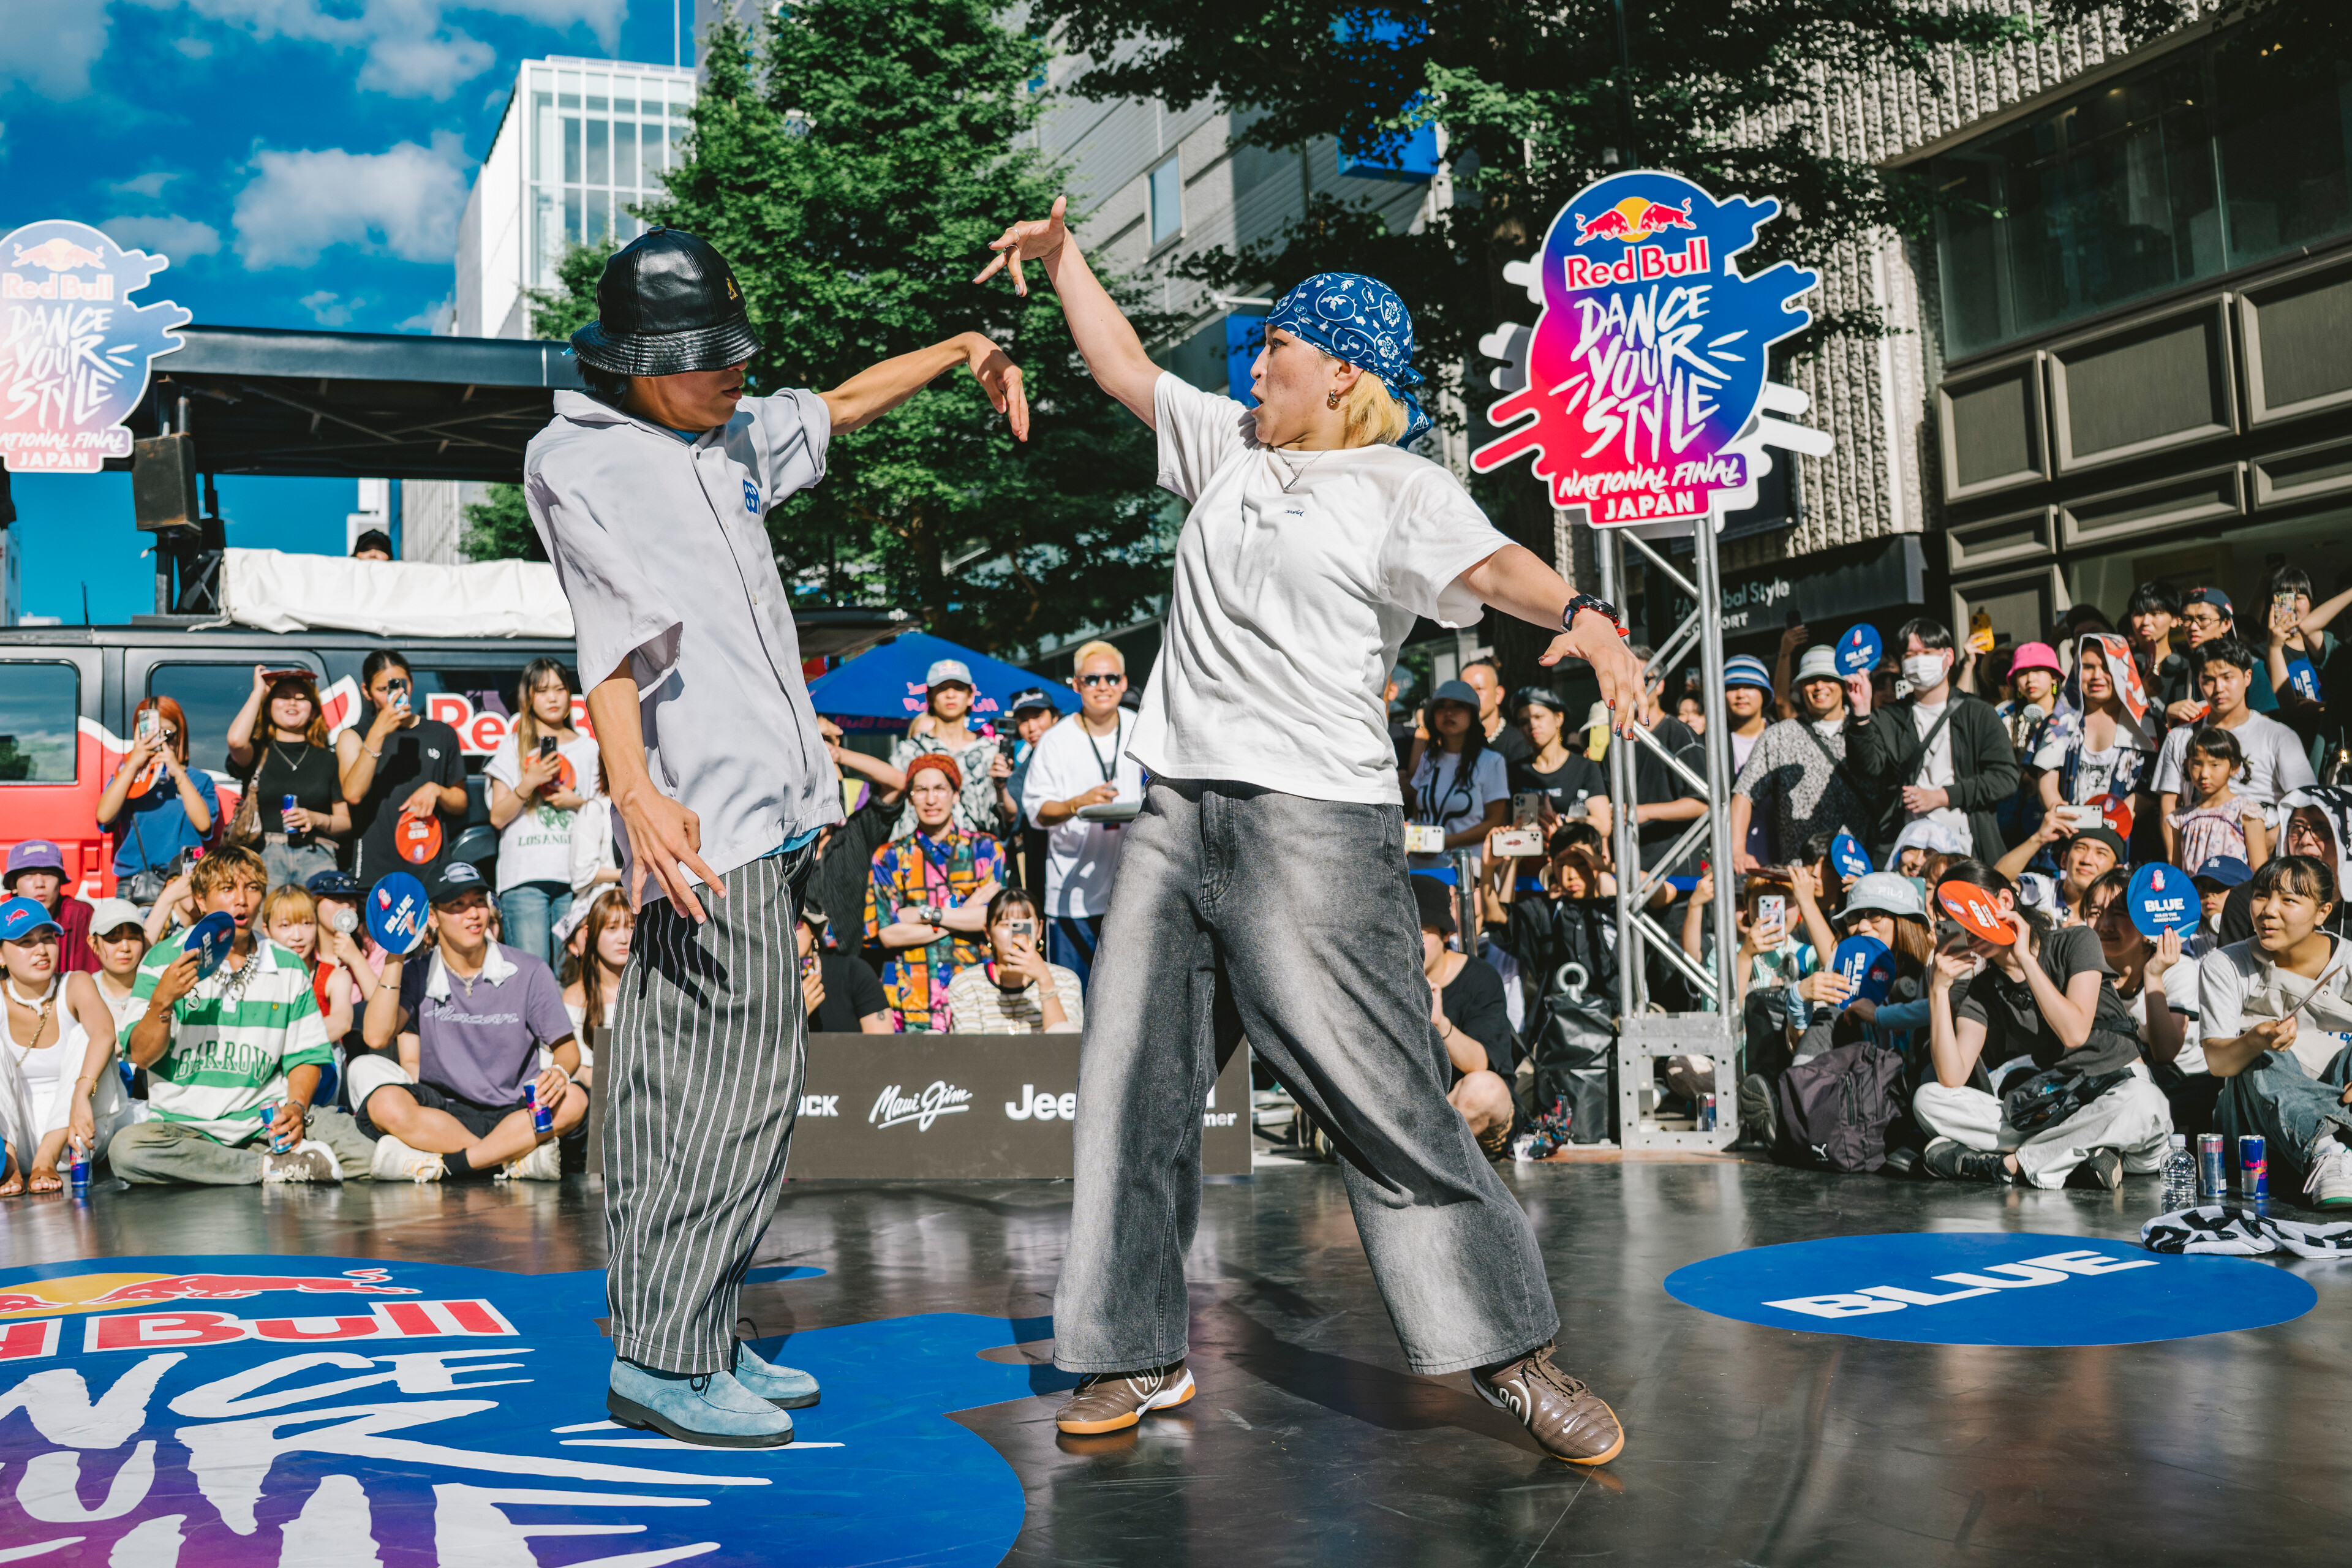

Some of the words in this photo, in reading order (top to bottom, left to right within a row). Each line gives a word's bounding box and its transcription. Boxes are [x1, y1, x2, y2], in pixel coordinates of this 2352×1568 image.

[2, 273, 59, 300] Red
[60, 273, 113, 300] Bull
[1564, 246, 1636, 292] Red
[1638, 236, 1711, 282] Bull
[3, 303, 114, 350] DANCE
[1570, 284, 1713, 362] DANCE
[11, 335, 124, 384] YOUR
[1587, 323, 1732, 407] YOUR
[4, 364, 116, 430] STYLE
[1581, 368, 1723, 465] STYLE
[0, 429, 70, 452] ATIONAL
[71, 427, 126, 453] FINAL
[19, 451, 89, 468] JAPAN
[1558, 466, 1669, 500] NATIONAL
[1671, 452, 1744, 489] FINAL
[1604, 491, 1695, 521] JAPAN
[1749, 576, 1790, 608] Style
[1683, 611, 1749, 638] COORT
[427, 693, 520, 756] Re
[902, 697, 929, 712] Re
[971, 697, 1000, 713] ull
[385, 894, 415, 934] BLUE
[1877, 886, 1904, 899] FILA
[2144, 897, 2185, 913] BLUE
[202, 931, 213, 969] BLUE
[1849, 952, 1866, 997] BLUE
[869, 1085, 920, 1123] Maui
[920, 1080, 973, 1131] Jim
[1005, 1084, 1077, 1121] Jee
[1761, 1250, 2160, 1319] BLUE
[86, 1299, 518, 1351] Bull
